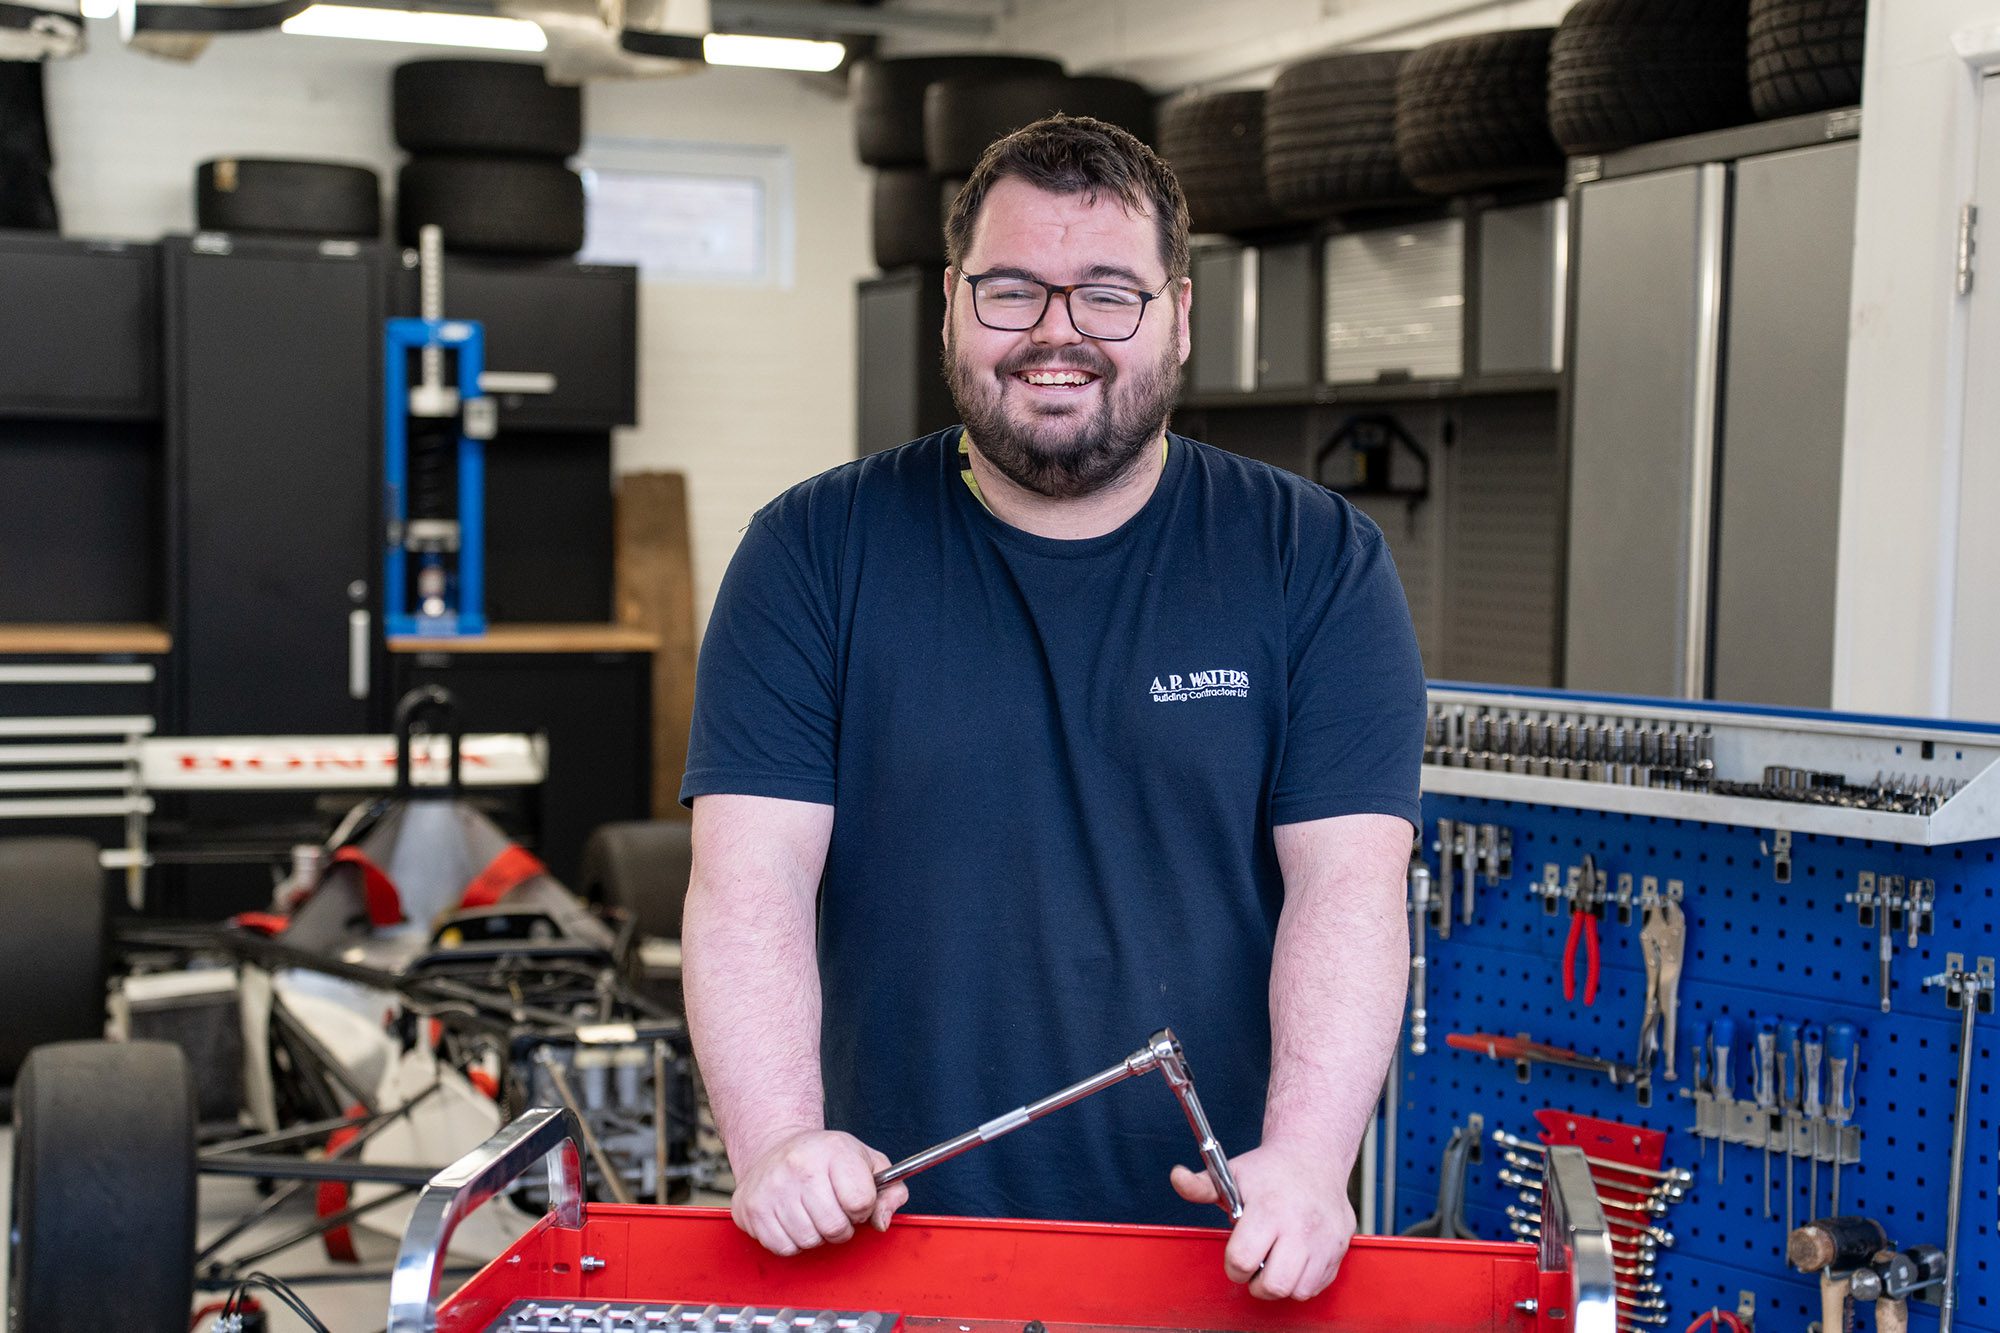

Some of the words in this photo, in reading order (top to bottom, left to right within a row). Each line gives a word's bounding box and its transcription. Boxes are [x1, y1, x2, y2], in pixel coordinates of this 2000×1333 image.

[1189, 669, 1249, 688] WATERS
[1153, 692, 1188, 702] Building
[1189, 688, 1237, 699] Contractors
[1237, 689, 1248, 698] Ltd
